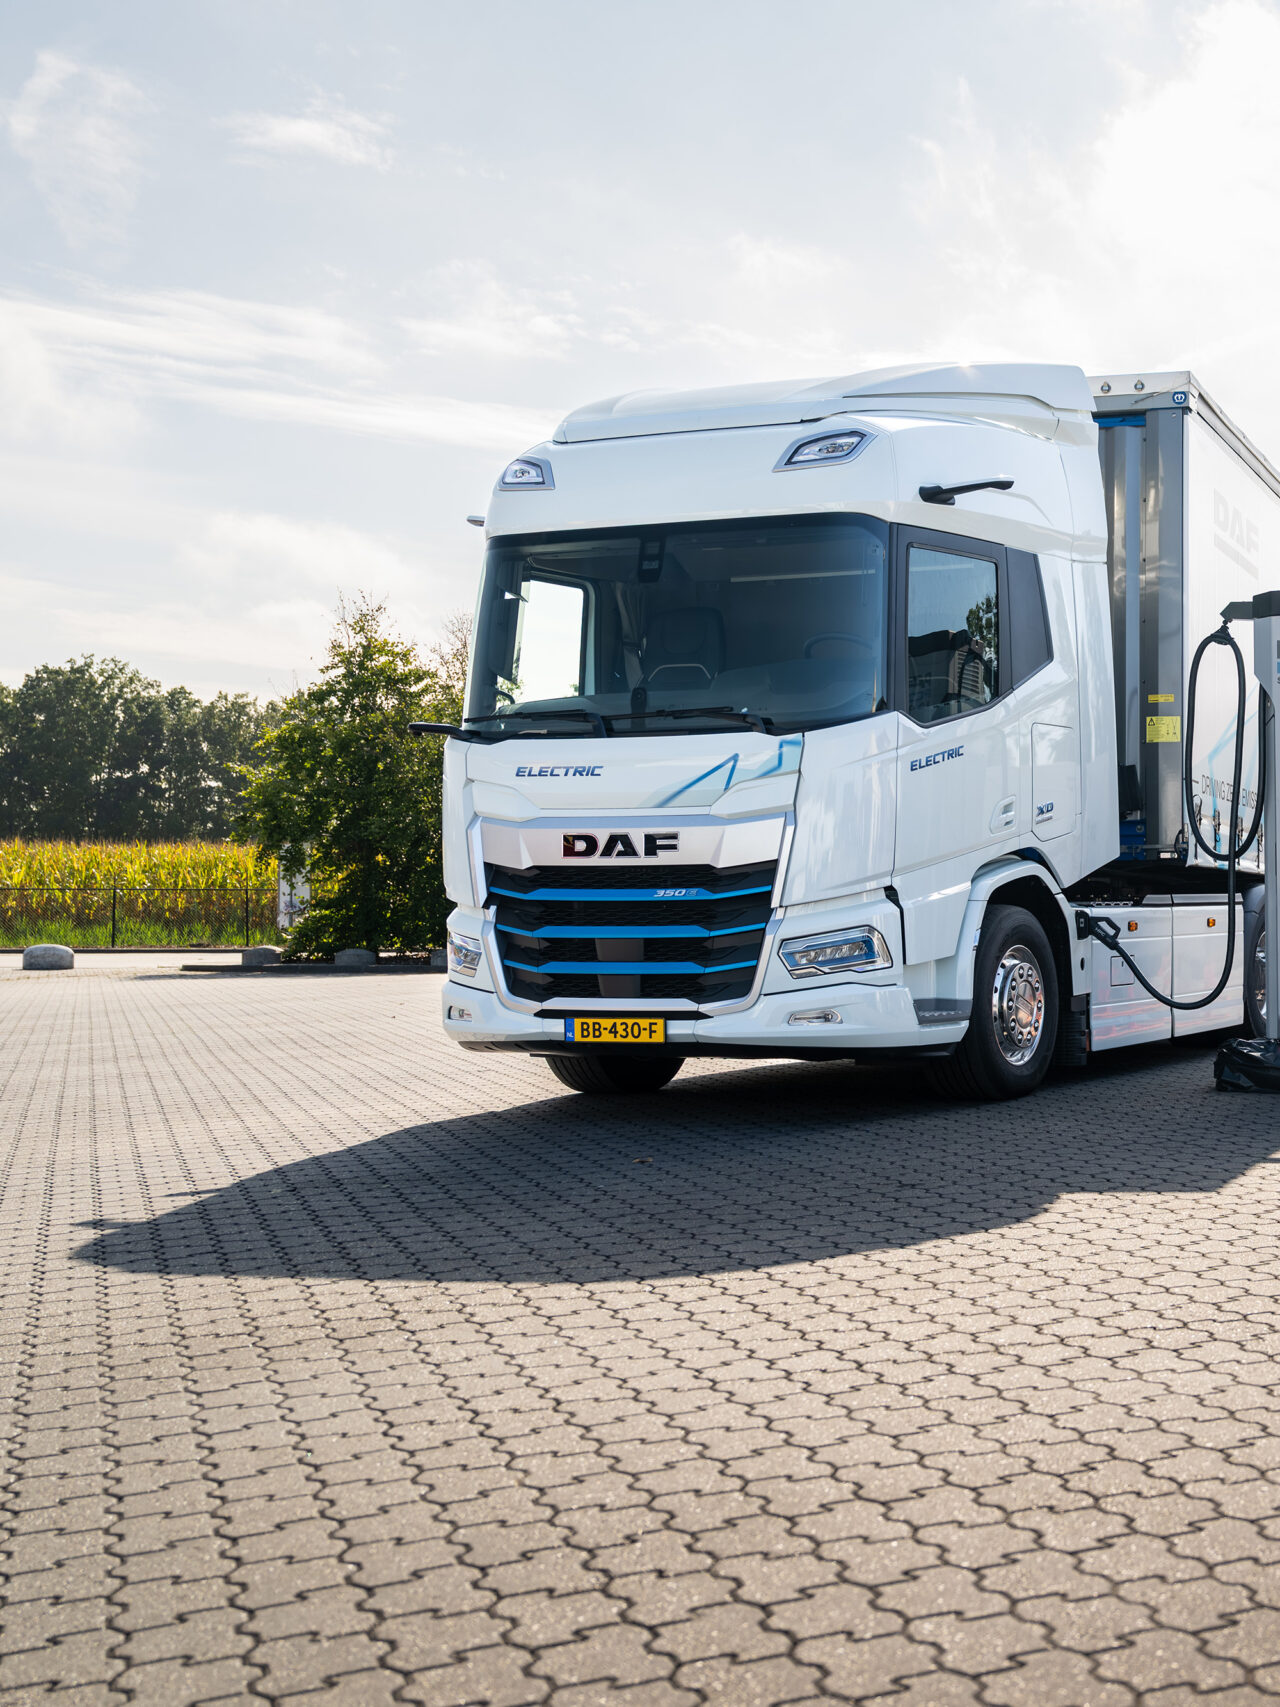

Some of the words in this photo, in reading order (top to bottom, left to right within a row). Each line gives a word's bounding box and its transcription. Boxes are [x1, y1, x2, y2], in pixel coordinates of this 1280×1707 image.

[1213, 487, 1259, 552] DAF
[515, 765, 604, 777] ELECTRIC
[910, 744, 965, 772] ELECTRIC
[561, 831, 680, 859] DAF
[580, 1021, 658, 1039] BB-430-F
